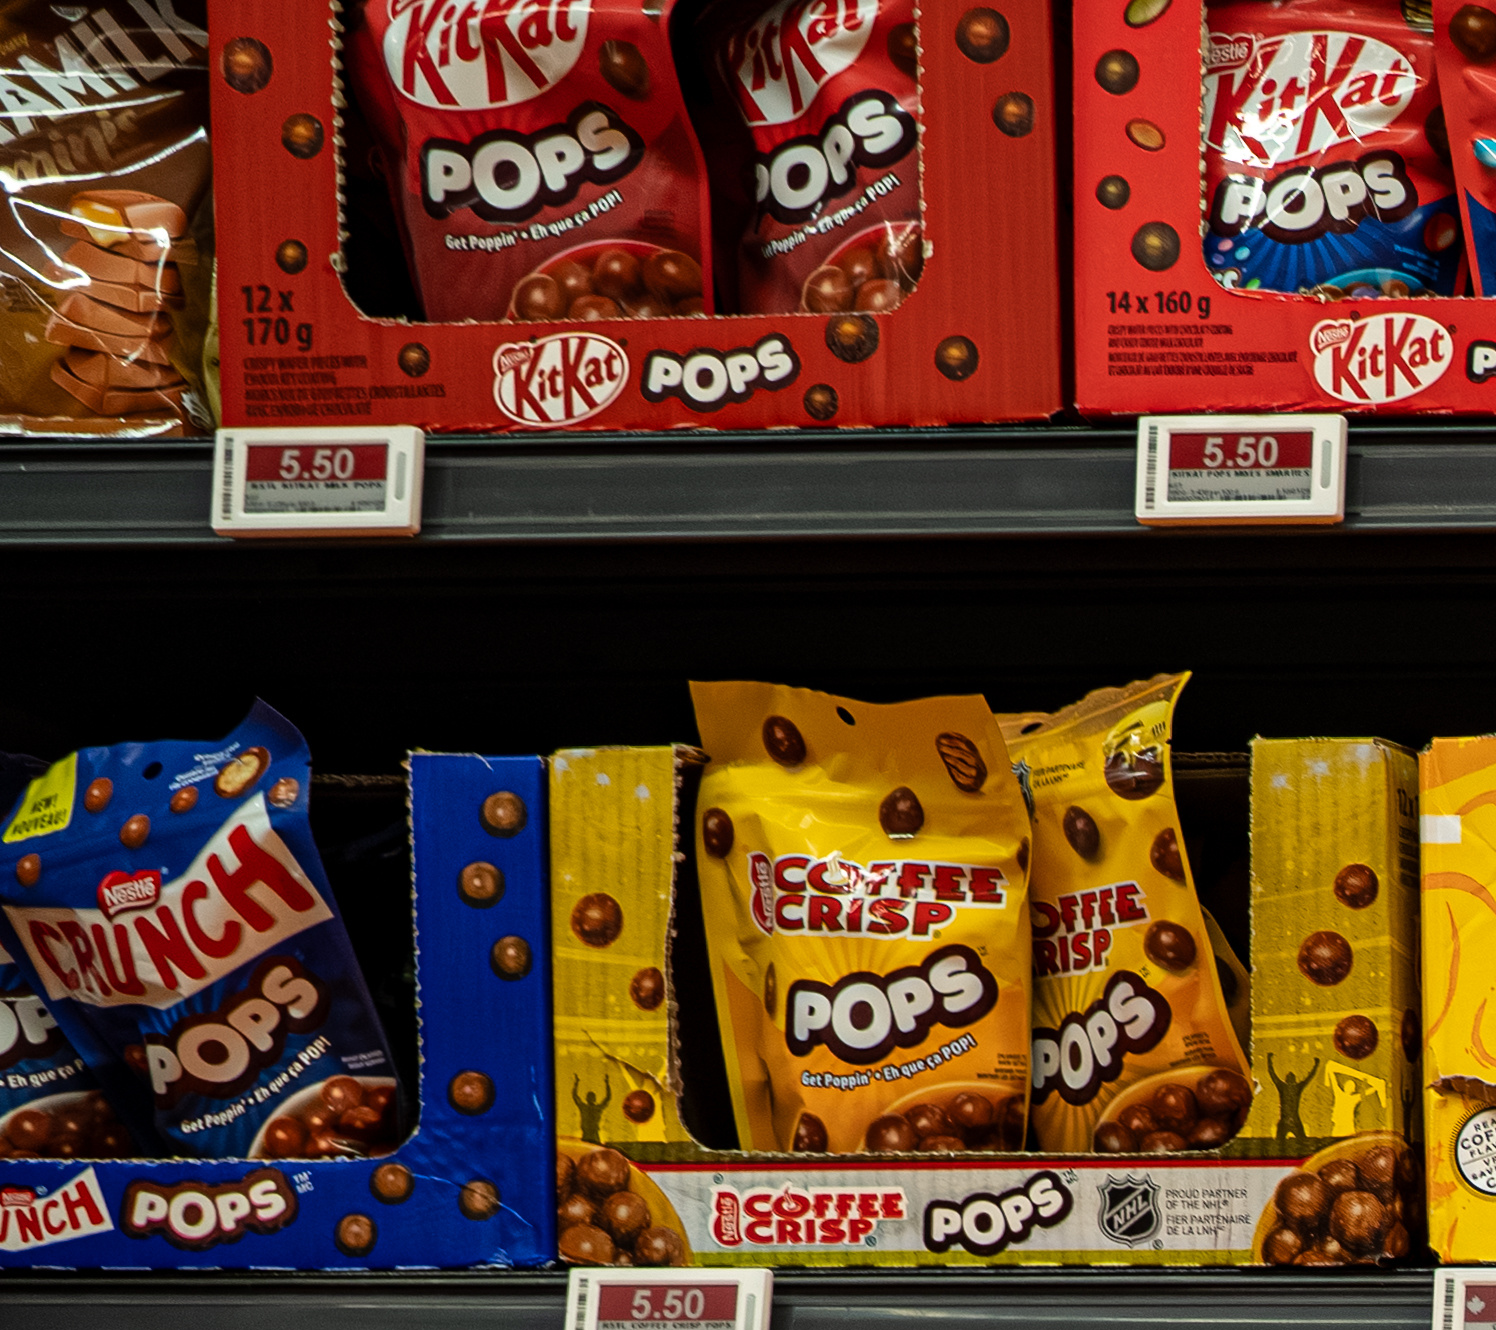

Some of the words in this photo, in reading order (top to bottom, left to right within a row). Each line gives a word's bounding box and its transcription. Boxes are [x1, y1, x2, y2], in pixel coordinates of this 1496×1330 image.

[242, 288, 270, 312] 12
[242, 320, 284, 344] 170
[509, 341, 623, 418] KitKat
[280, 449, 354, 479] 5.50
[1205, 438, 1277, 467] 5.50
[39, 824, 312, 998] CRUNCH
[743, 1191, 906, 1221] COFFEE
[1203, 1188, 1247, 1199] PARTNER
[1113, 1195, 1146, 1227] NHL
[744, 1218, 873, 1244] CRISP
[631, 1289, 705, 1319] 5.50
